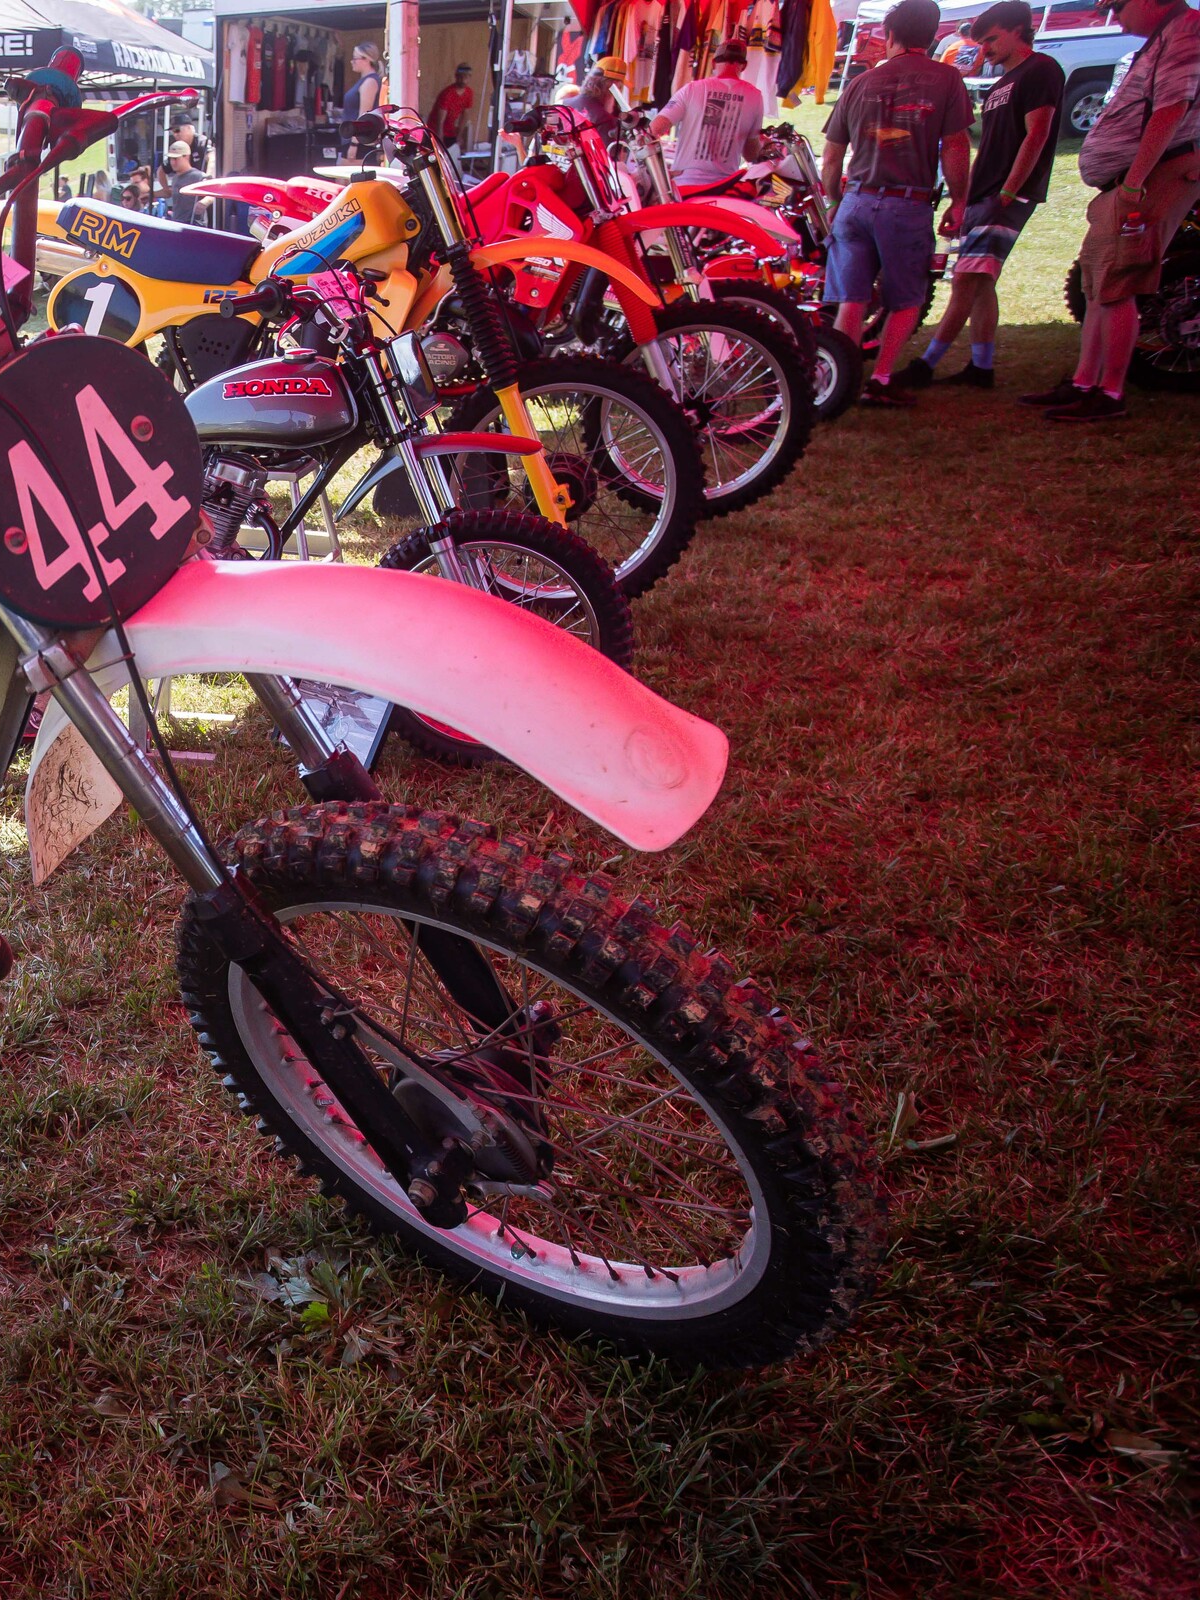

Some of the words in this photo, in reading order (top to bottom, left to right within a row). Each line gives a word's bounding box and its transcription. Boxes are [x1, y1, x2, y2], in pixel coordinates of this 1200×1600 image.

[707, 91, 744, 102] FREEDOM
[305, 187, 336, 202] HO
[70, 207, 141, 258] RM
[284, 198, 361, 255] SUZUKI
[84, 281, 115, 337] 1
[202, 289, 239, 304] 125
[223, 378, 332, 400] HONDA
[7, 384, 191, 603] 44
